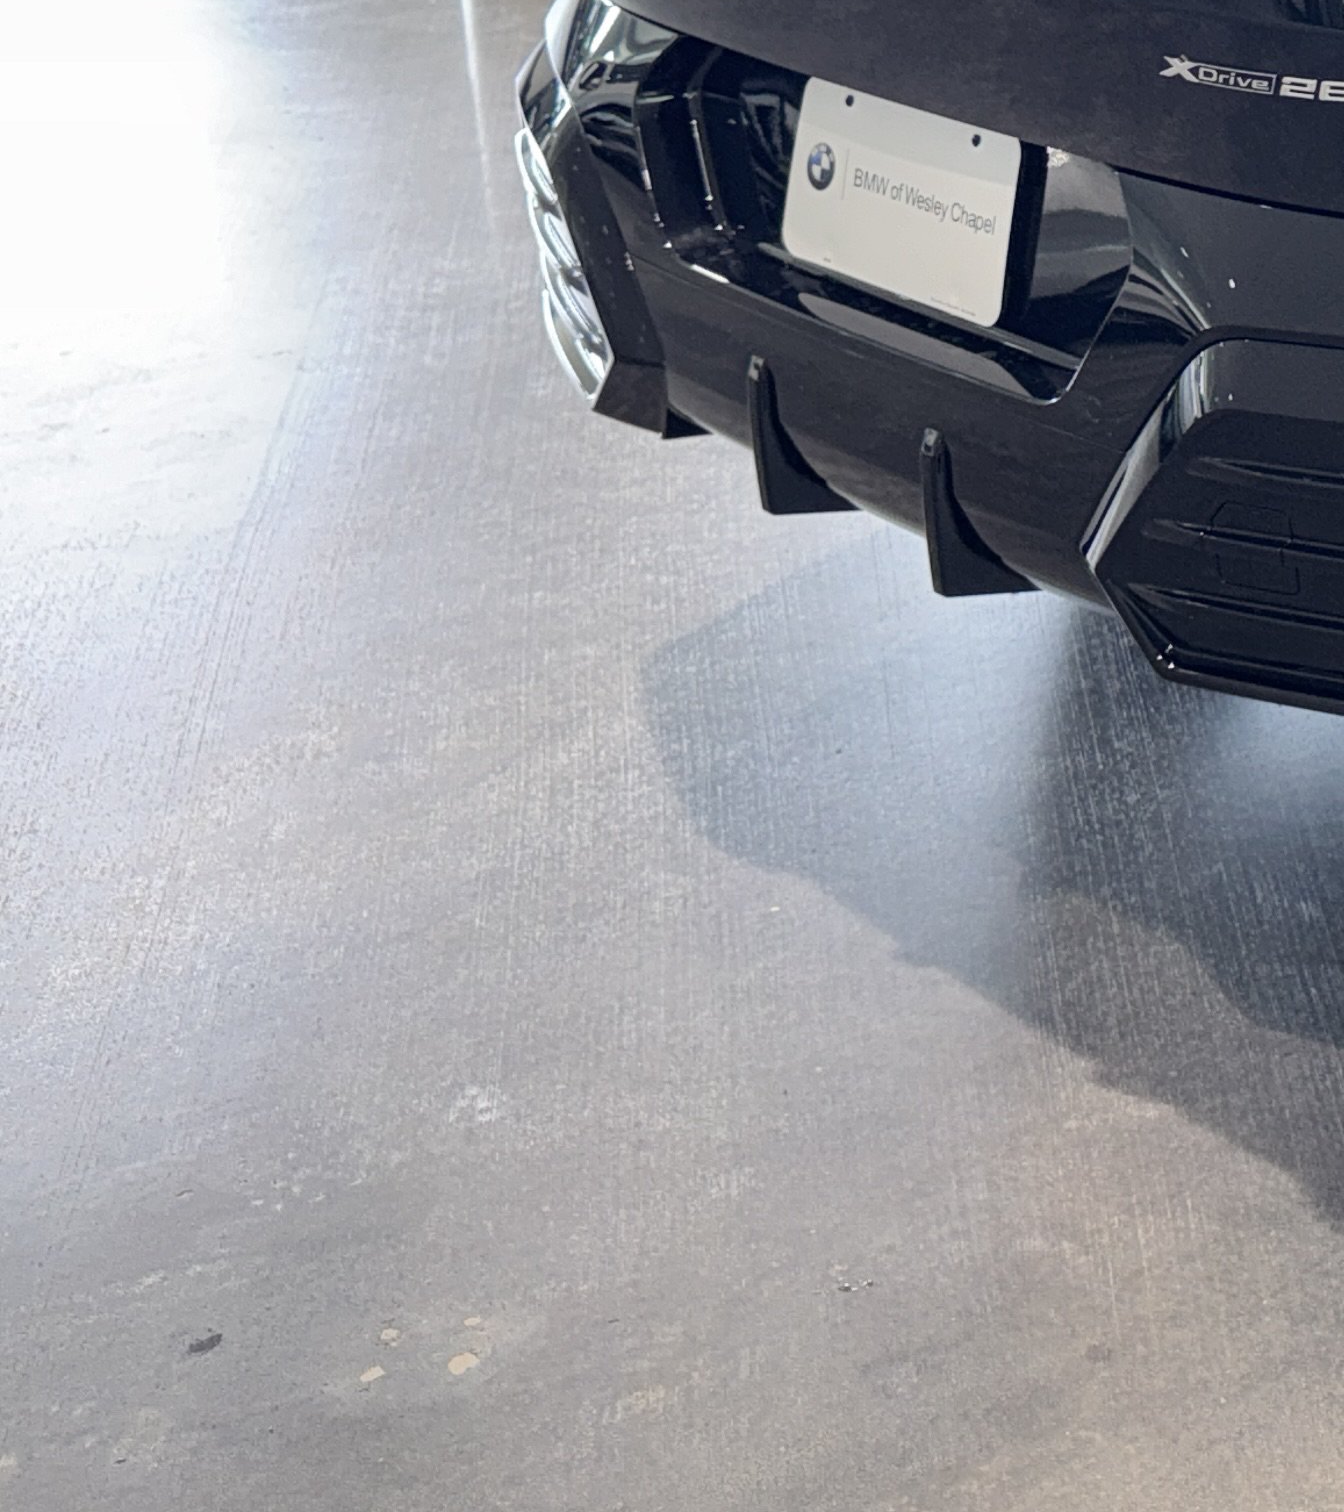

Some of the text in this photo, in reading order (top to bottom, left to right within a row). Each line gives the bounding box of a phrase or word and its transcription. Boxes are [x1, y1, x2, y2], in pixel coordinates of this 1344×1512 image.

[853, 168, 997, 235] BMW of Wesley Chapel
